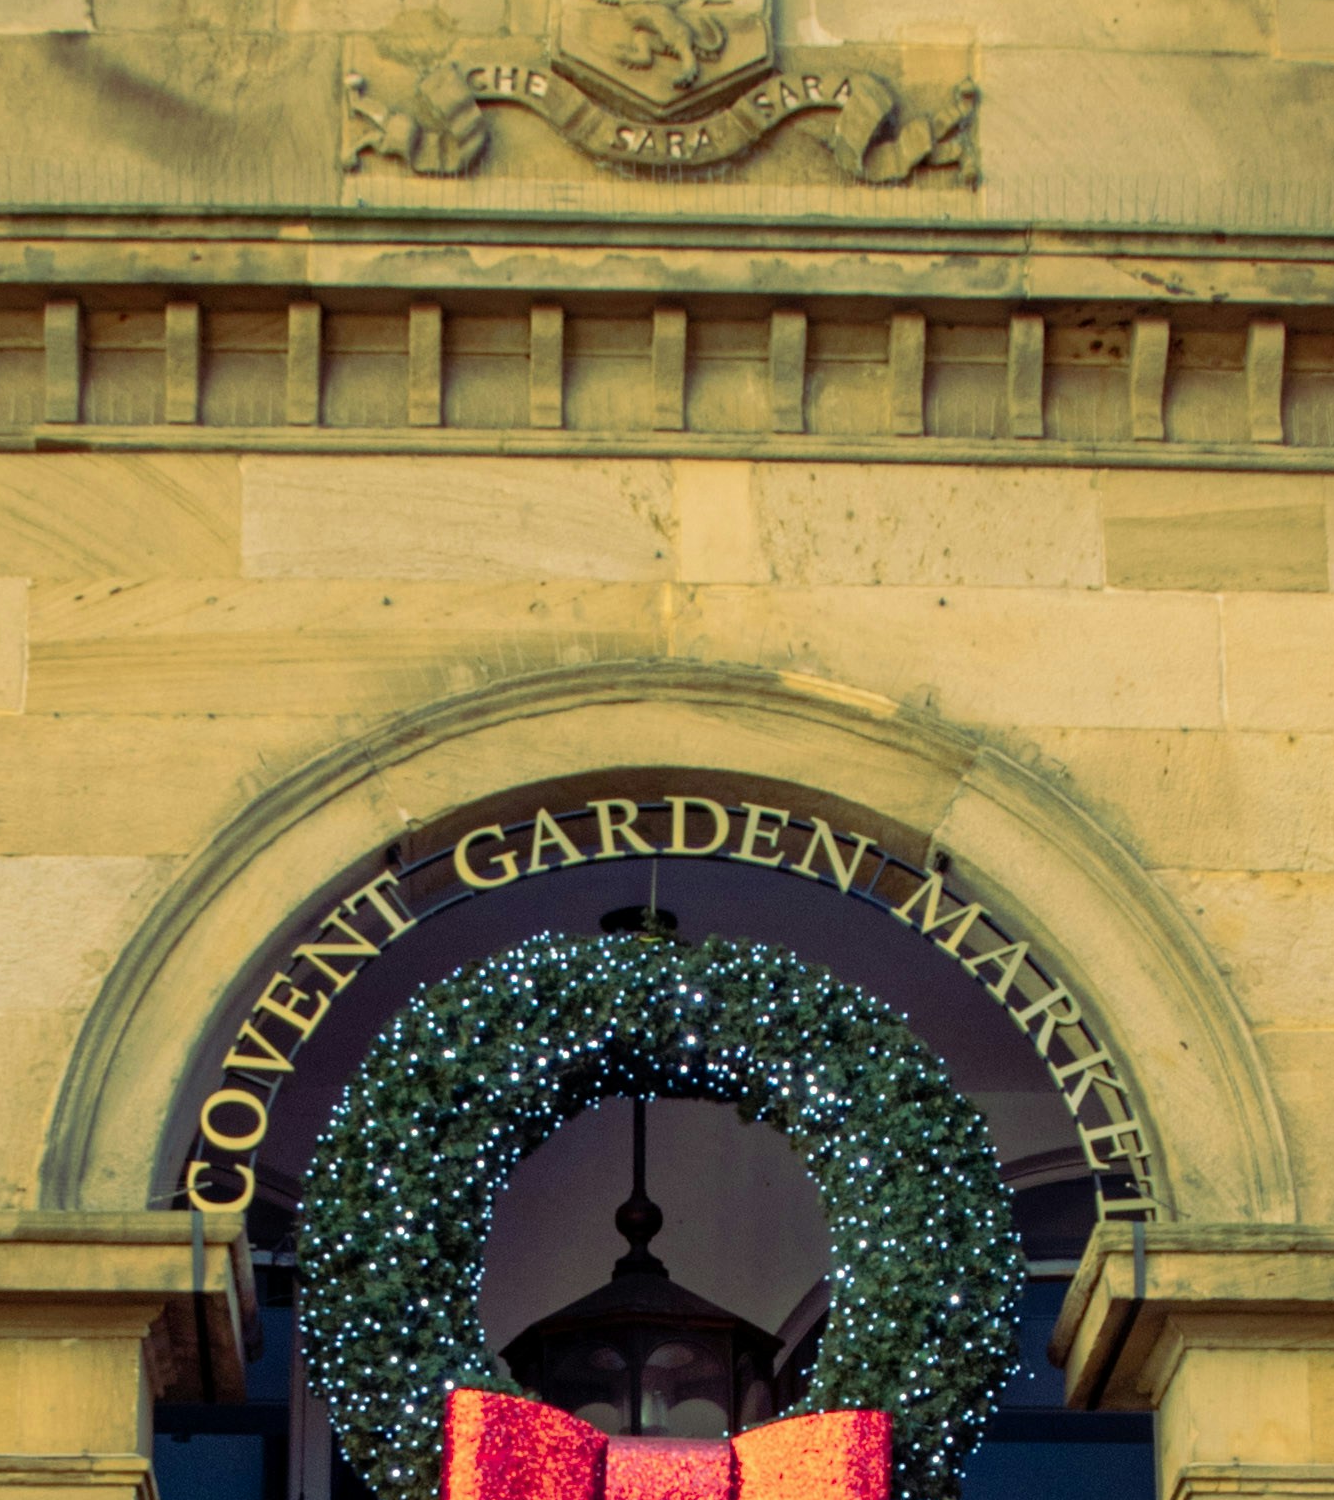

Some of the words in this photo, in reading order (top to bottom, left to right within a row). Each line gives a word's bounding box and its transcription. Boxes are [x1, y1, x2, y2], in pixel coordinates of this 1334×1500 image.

[613, 127, 713, 158] SARA
[186, 871, 418, 1213] COVENT
[453, 795, 877, 895] GARDEN
[890, 873, 1160, 1222] MARKET
